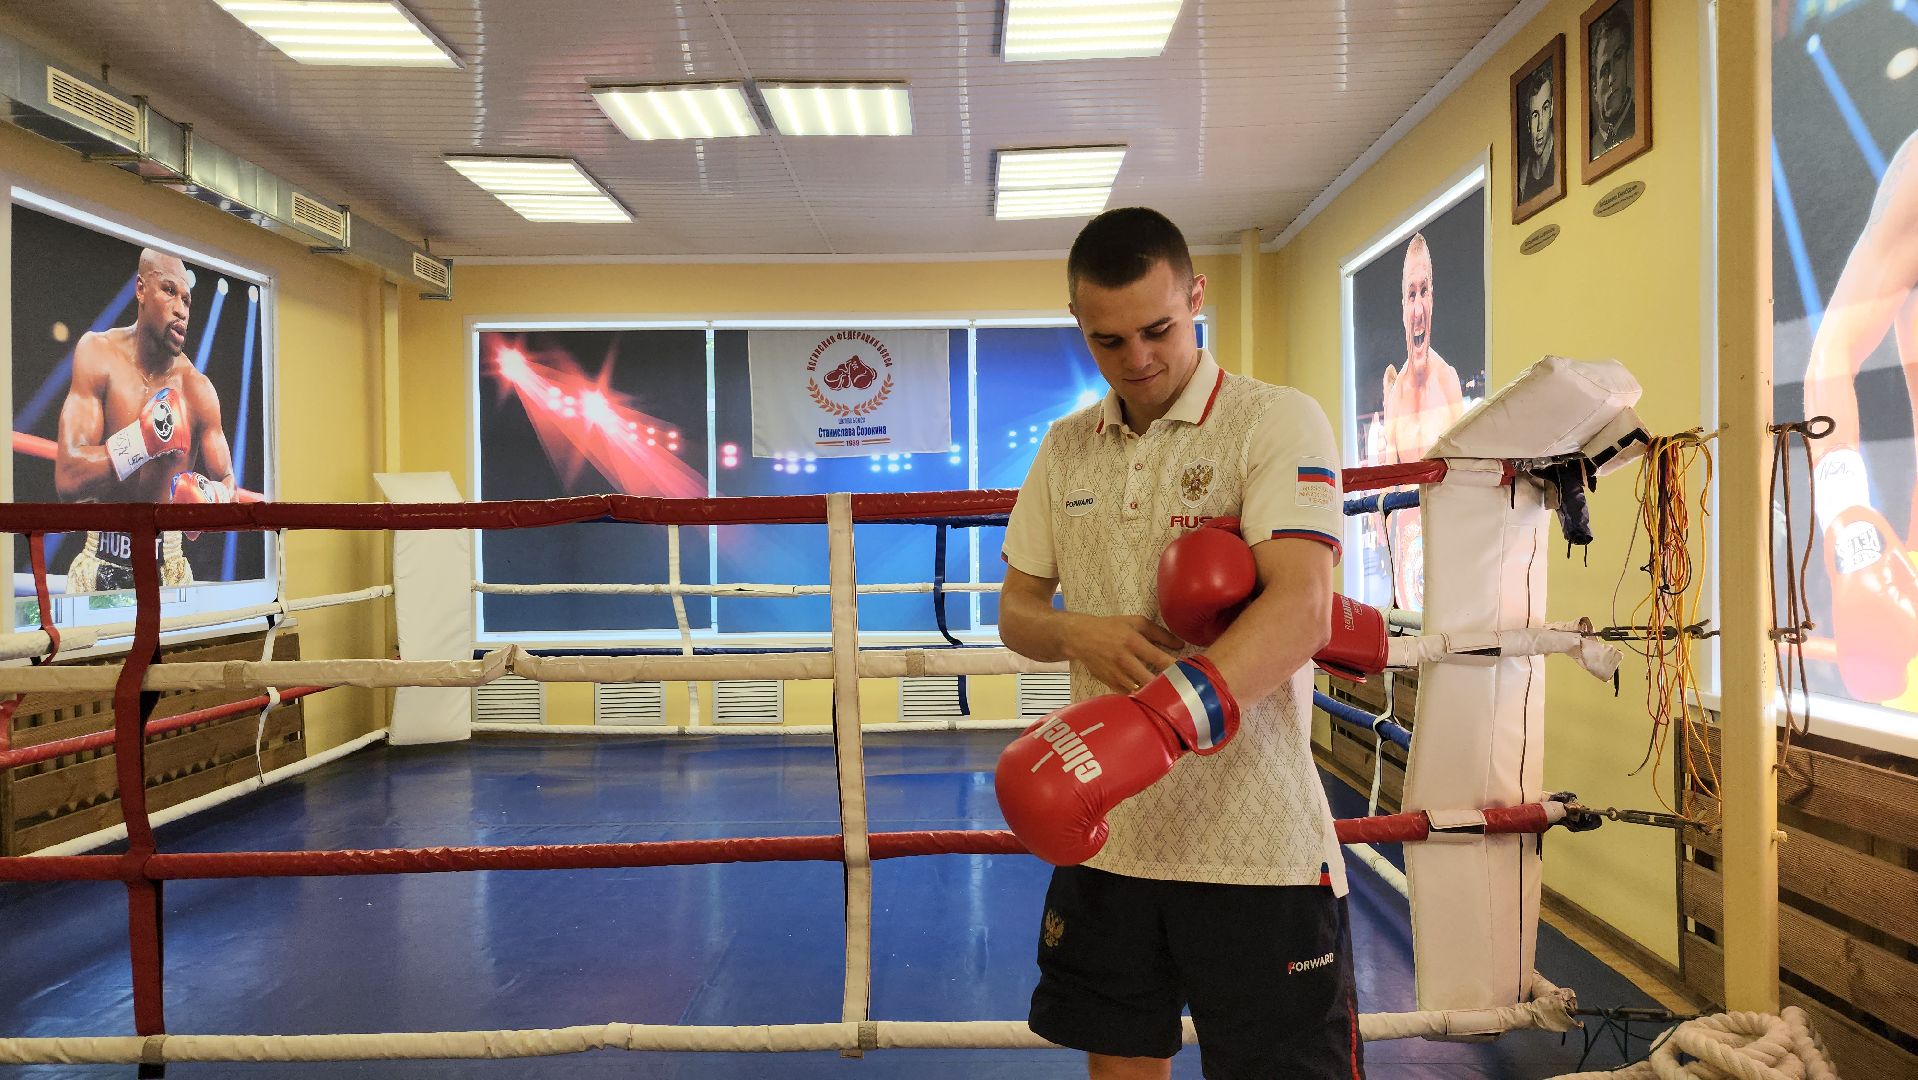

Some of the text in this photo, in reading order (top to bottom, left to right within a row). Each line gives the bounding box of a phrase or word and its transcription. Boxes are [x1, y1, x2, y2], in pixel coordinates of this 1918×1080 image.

[818, 425, 887, 438] Станислава Сорокина
[1065, 497, 1093, 509] FORWARD
[99, 532, 163, 560] HUBT
[1287, 952, 1334, 975] FORWARD
